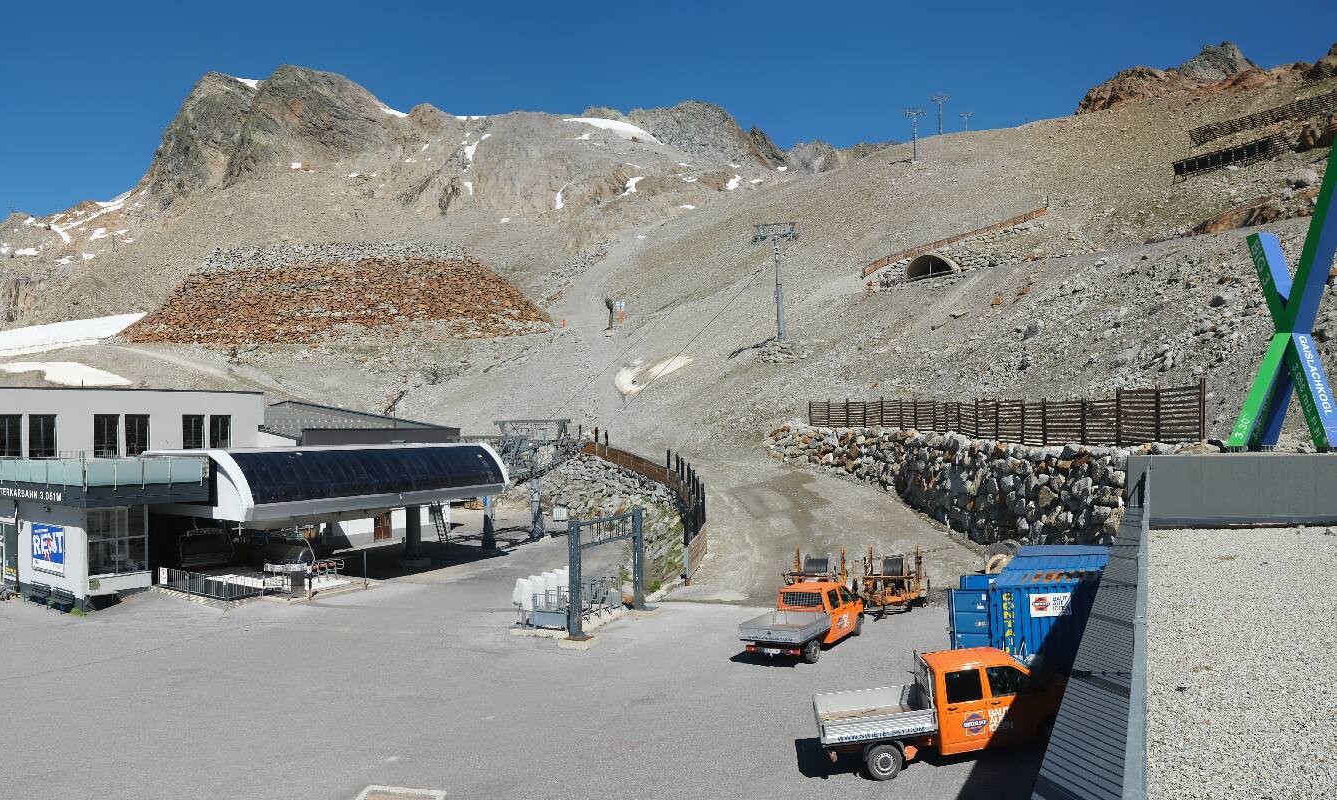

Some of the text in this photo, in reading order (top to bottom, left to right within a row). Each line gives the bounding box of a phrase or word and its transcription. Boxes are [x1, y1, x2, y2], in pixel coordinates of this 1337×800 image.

[1251, 239, 1271, 286] BIG 3
[1298, 335, 1332, 415] GAISLACHKOGL
[1234, 414, 1250, 439] 3.30
[32, 532, 64, 556] RENT
[988, 706, 1011, 718] BAUT
